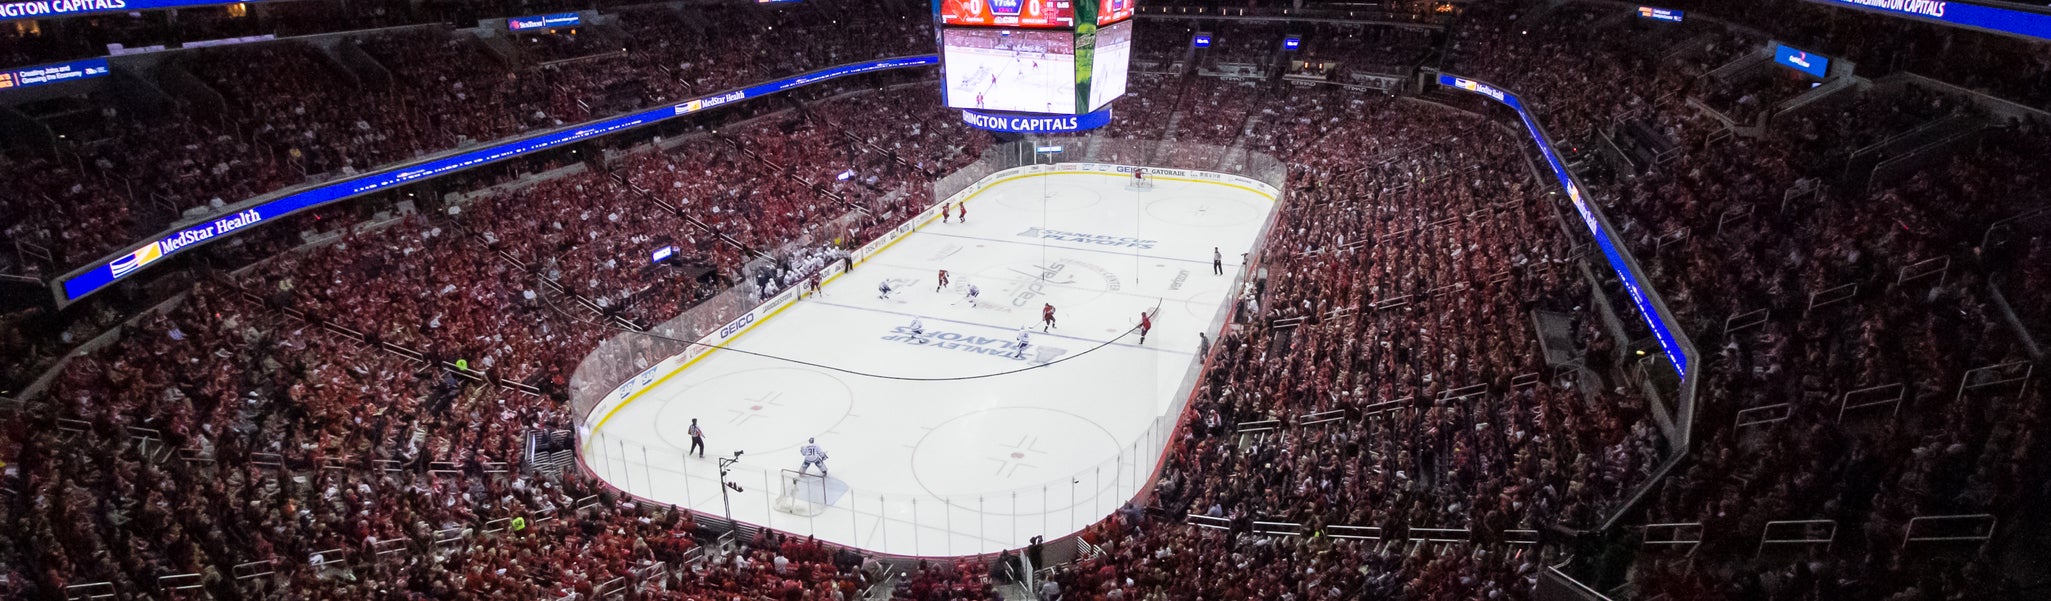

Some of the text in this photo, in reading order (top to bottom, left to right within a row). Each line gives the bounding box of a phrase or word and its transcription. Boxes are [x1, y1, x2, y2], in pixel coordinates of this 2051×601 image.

[53, 0, 126, 12] CAPITALS
[1904, 0, 1946, 17] CAPITALS
[701, 90, 745, 108] MedStar Health
[1011, 117, 1078, 131] CAPITALS
[1151, 169, 1186, 177] GATORADE
[160, 209, 261, 255] MedStar Health
[720, 312, 755, 339] GEICO
[807, 448, 815, 456] 31
